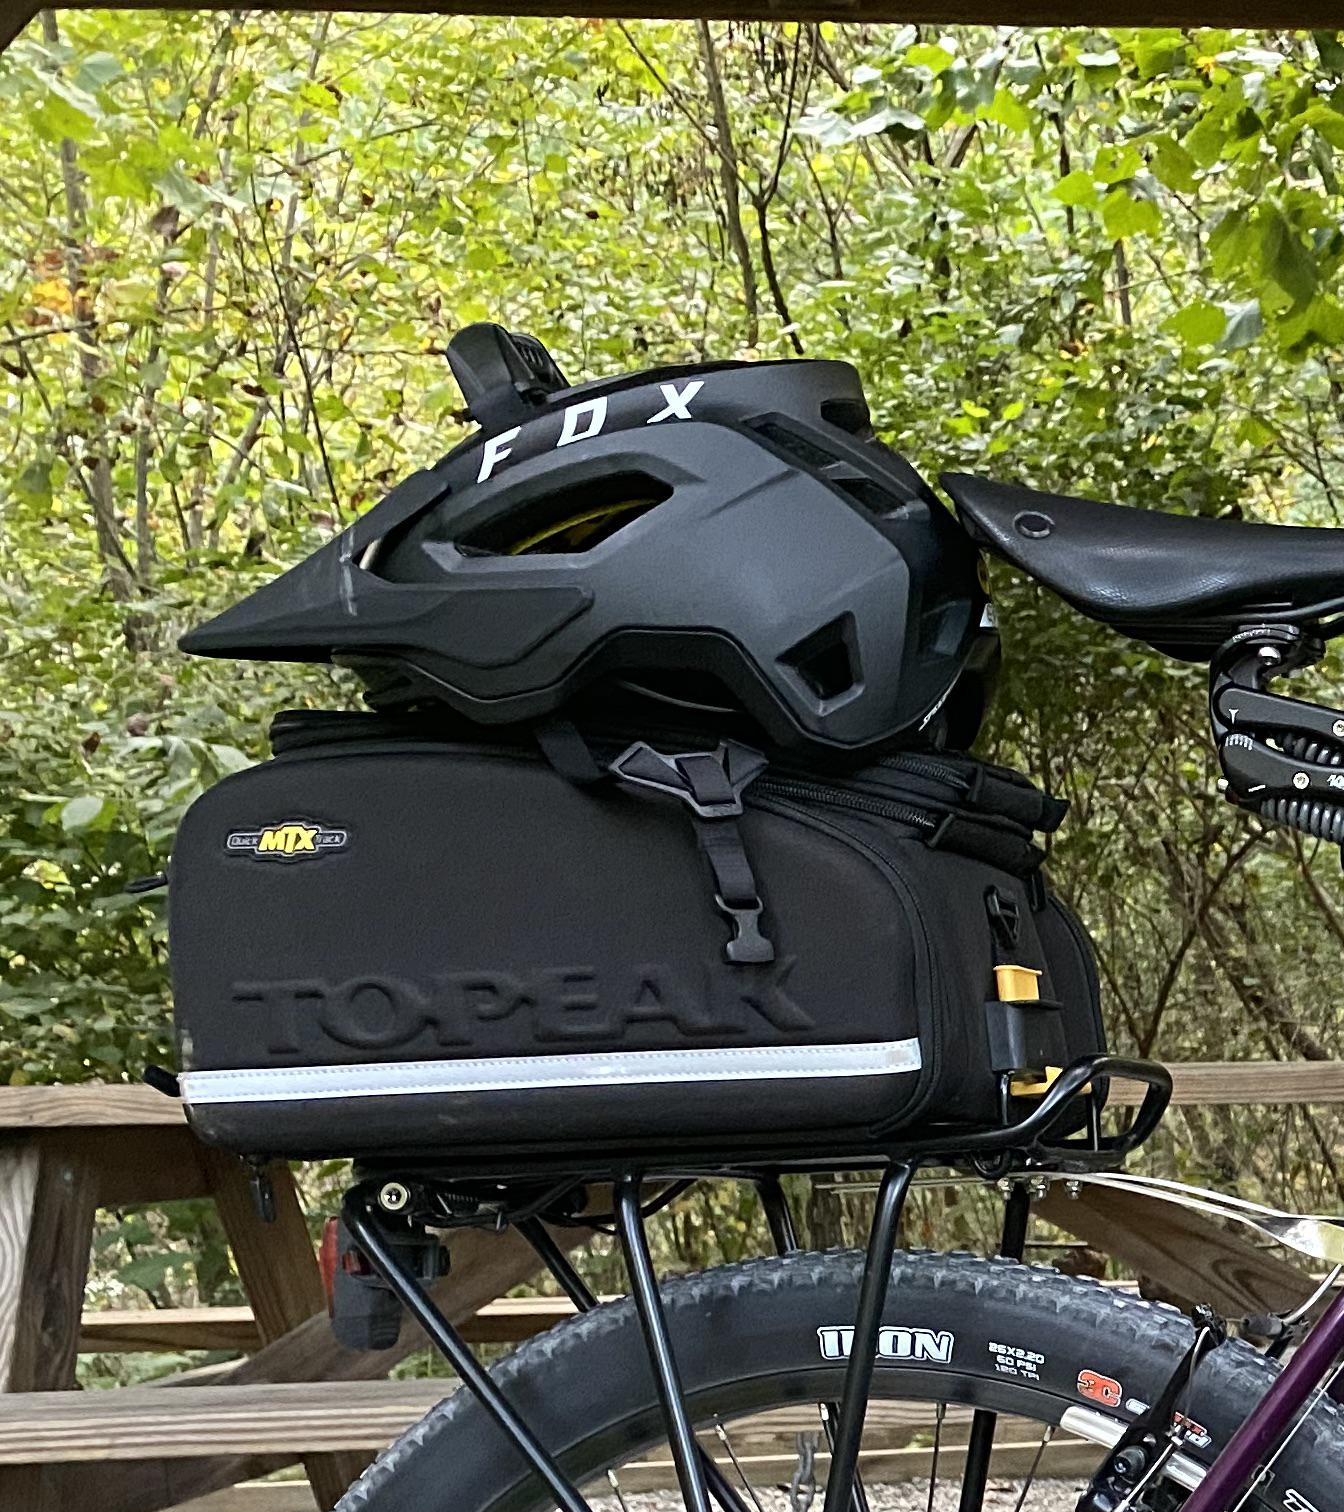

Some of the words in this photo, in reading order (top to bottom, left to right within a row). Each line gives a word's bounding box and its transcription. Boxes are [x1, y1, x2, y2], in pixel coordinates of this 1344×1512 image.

[477, 379, 705, 483] FOX
[258, 825, 318, 854] MTX
[232, 956, 816, 1056] TOPEAK
